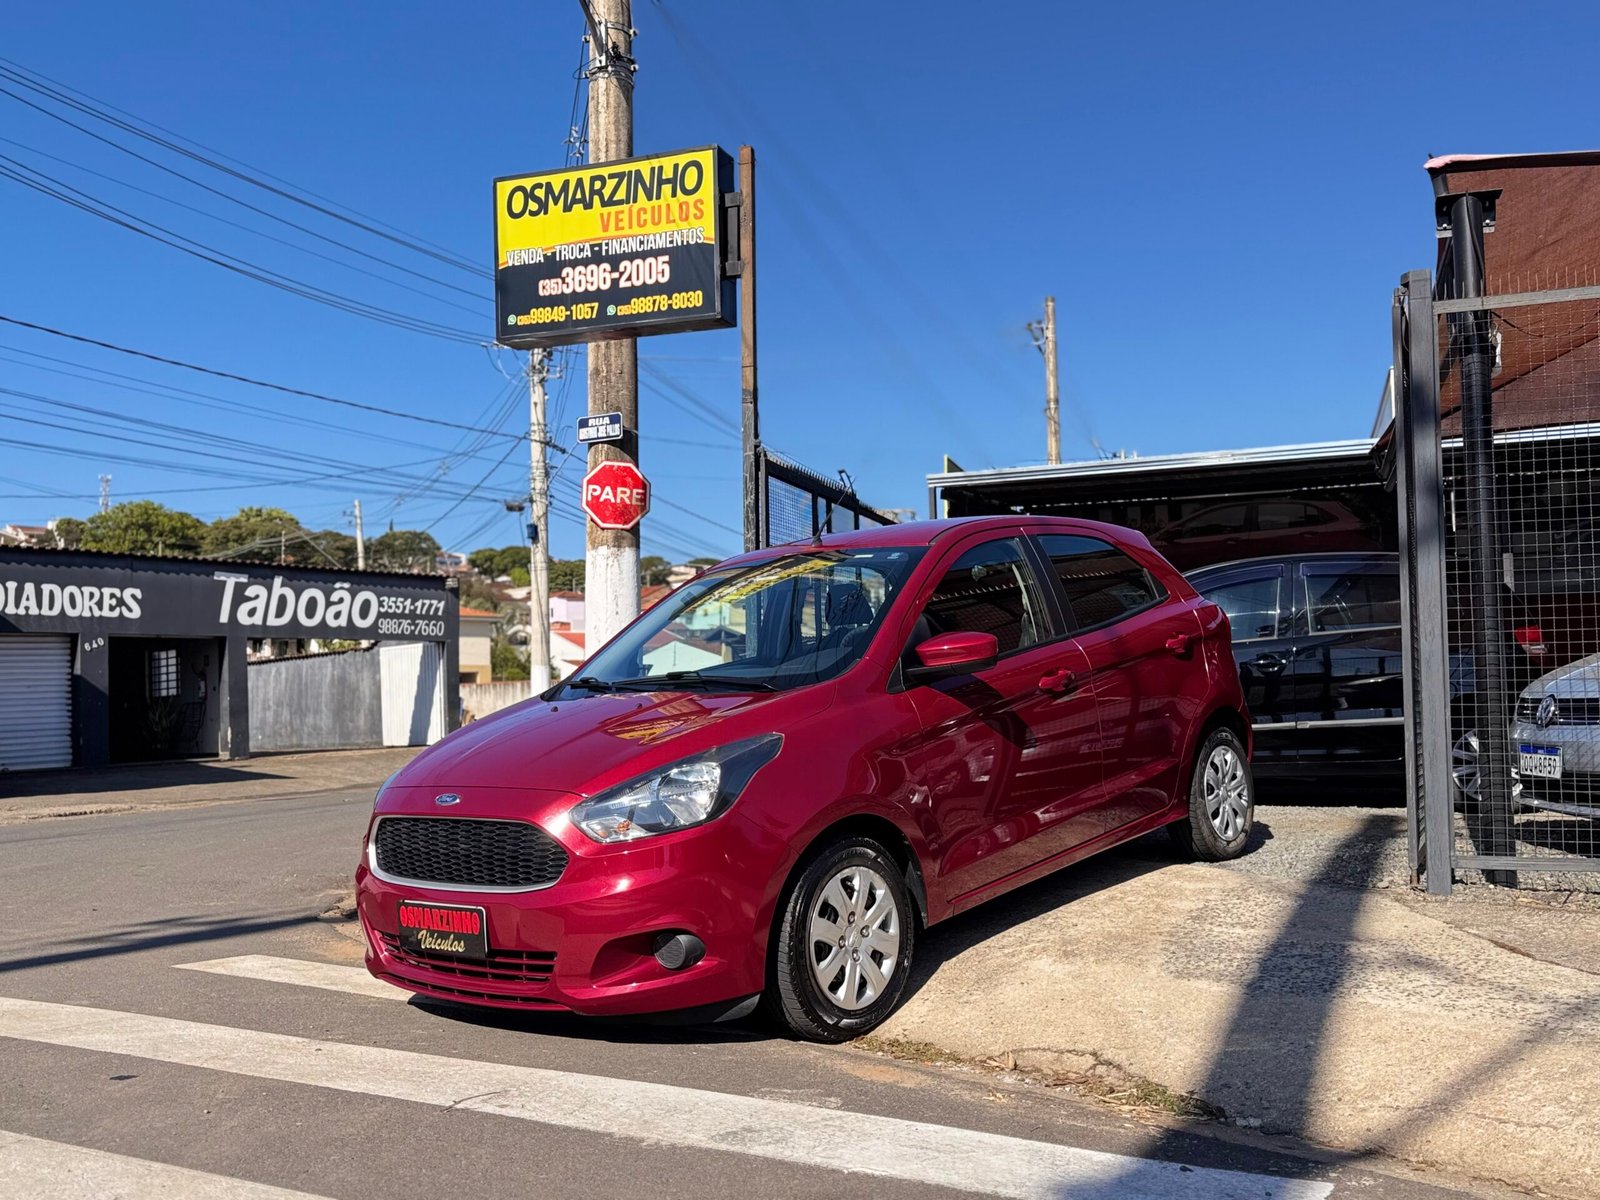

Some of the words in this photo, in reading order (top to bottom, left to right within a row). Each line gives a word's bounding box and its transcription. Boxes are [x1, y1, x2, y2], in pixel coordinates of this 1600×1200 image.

[506, 160, 704, 219] OSMARZINHO
[600, 198, 705, 233] VEÍCULOS
[506, 247, 544, 266] VENDA
[555, 241, 592, 261] TROCA
[602, 226, 704, 256] FINANCIAMENTOS
[538, 255, 670, 296] (35)3696-2005
[588, 416, 610, 427] RUA
[587, 484, 646, 506] PARE
[0, 580, 142, 619] IADORES
[213, 571, 378, 629] Taboão
[84, 637, 104, 651] 640
[400, 905, 480, 935] OSMARZINHO
